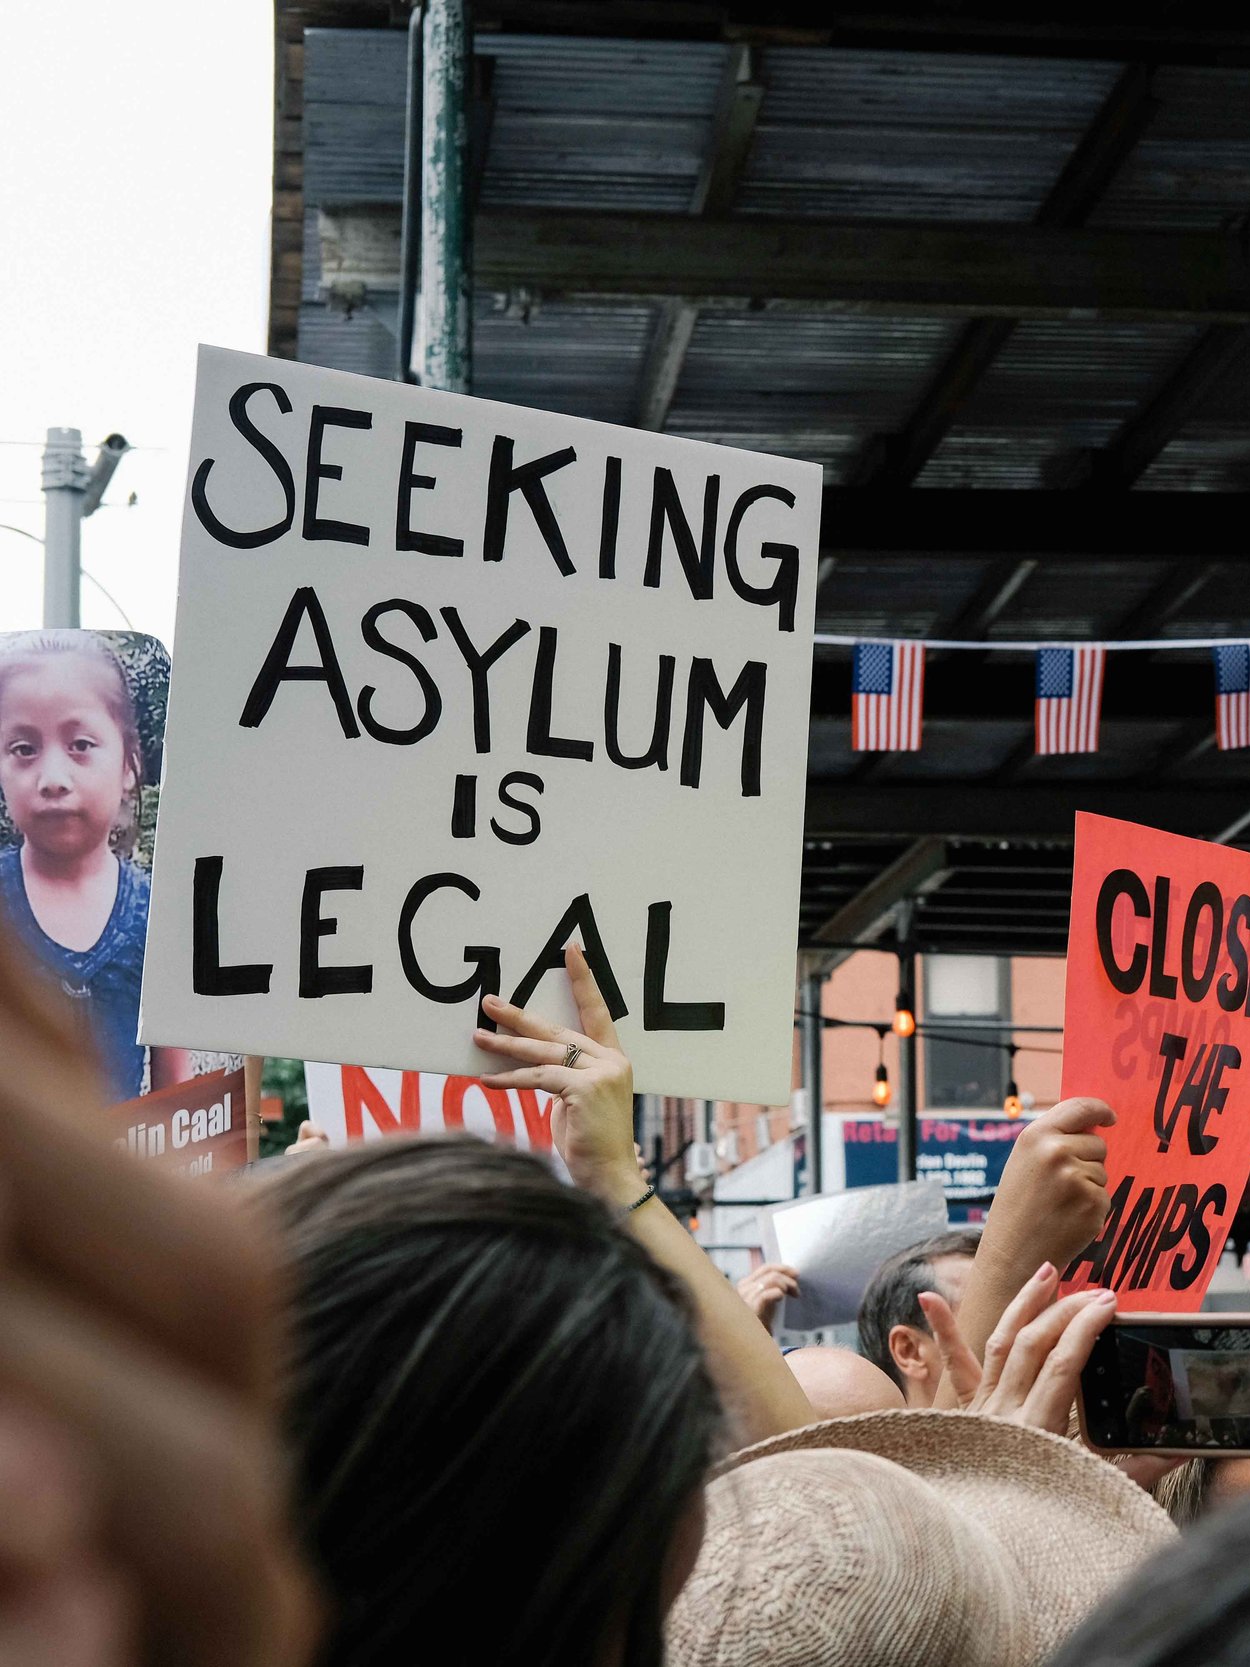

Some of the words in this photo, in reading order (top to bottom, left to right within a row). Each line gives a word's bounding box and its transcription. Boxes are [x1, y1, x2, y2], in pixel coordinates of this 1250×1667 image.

[192, 383, 799, 632] SEEKING
[238, 586, 768, 797] ASYLUM
[451, 770, 544, 846] IS
[192, 855, 725, 1032] LEGAL
[171, 1092, 232, 1149] Caal
[1153, 1032, 1242, 1156] THE
[1061, 1176, 1228, 1292] AMPS
